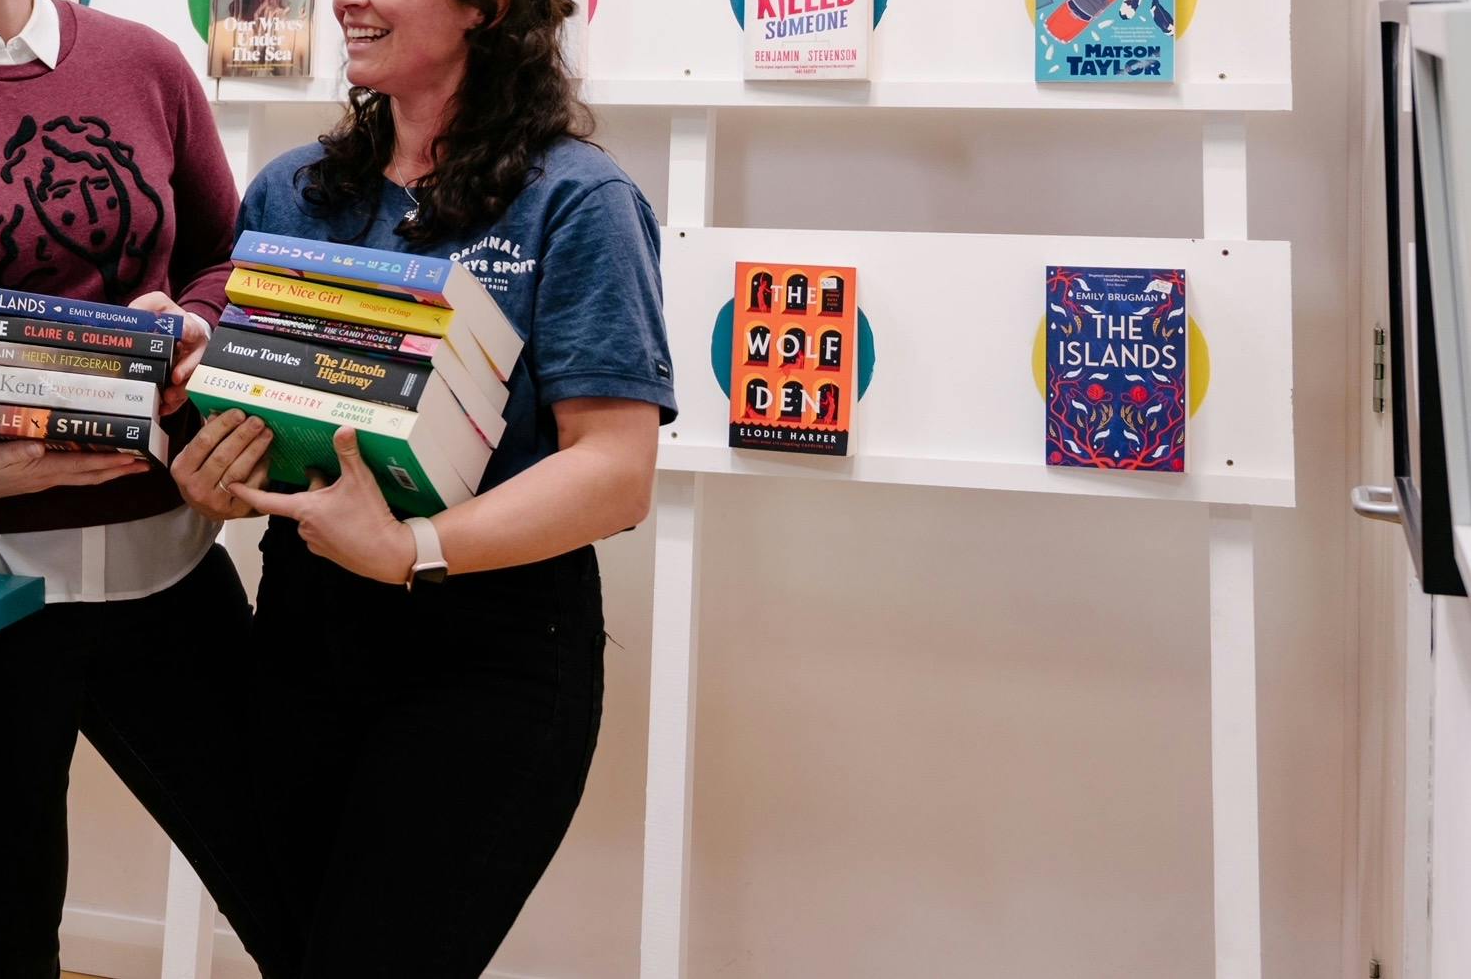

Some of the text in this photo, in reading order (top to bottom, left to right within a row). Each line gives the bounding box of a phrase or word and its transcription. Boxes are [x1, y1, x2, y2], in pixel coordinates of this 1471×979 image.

[223, 17, 304, 31] Our Wives
[764, 10, 848, 41] SOMEONE
[232, 47, 292, 62] The Sea
[754, 48, 858, 62] BENJAMIN STEVENSON
[1085, 43, 1162, 59] MATSON
[1066, 56, 1162, 76] TAYLOR
[492, 259, 536, 274] SPORT
[242, 275, 412, 320] A Very Nice Girl Imogen Crimp
[771, 285, 817, 306] THE
[1075, 291, 1158, 303] EMILY BRUGMAN
[69, 307, 94, 320] EMILY
[94, 310, 138, 325] BRUGMAN
[24, 325, 63, 341] CLAIRE
[67, 330, 78, 342] G.
[82, 332, 133, 348] COLEMAN
[323, 326, 394, 344] THE CANDY HOUSE
[1090, 314, 1143, 340] THE
[222, 340, 302, 367] Amor Towles
[745, 331, 840, 360] WOLF
[1058, 341, 1177, 369] ISLANDS
[22, 352, 57, 366] HELEN
[60, 355, 124, 373] FITZGERALD
[314, 352, 387, 379] The Lincoln
[0, 374, 46, 397] Kent
[315, 367, 374, 391] Highway
[203, 374, 323, 409] LESSONS CHEMISTRY
[755, 386, 821, 414] DEN
[331, 409, 373, 426] GARMUS
[335, 401, 376, 418] BONNIE
[56, 419, 116, 439] STILL
[739, 428, 837, 444] ELODIE HARPER
